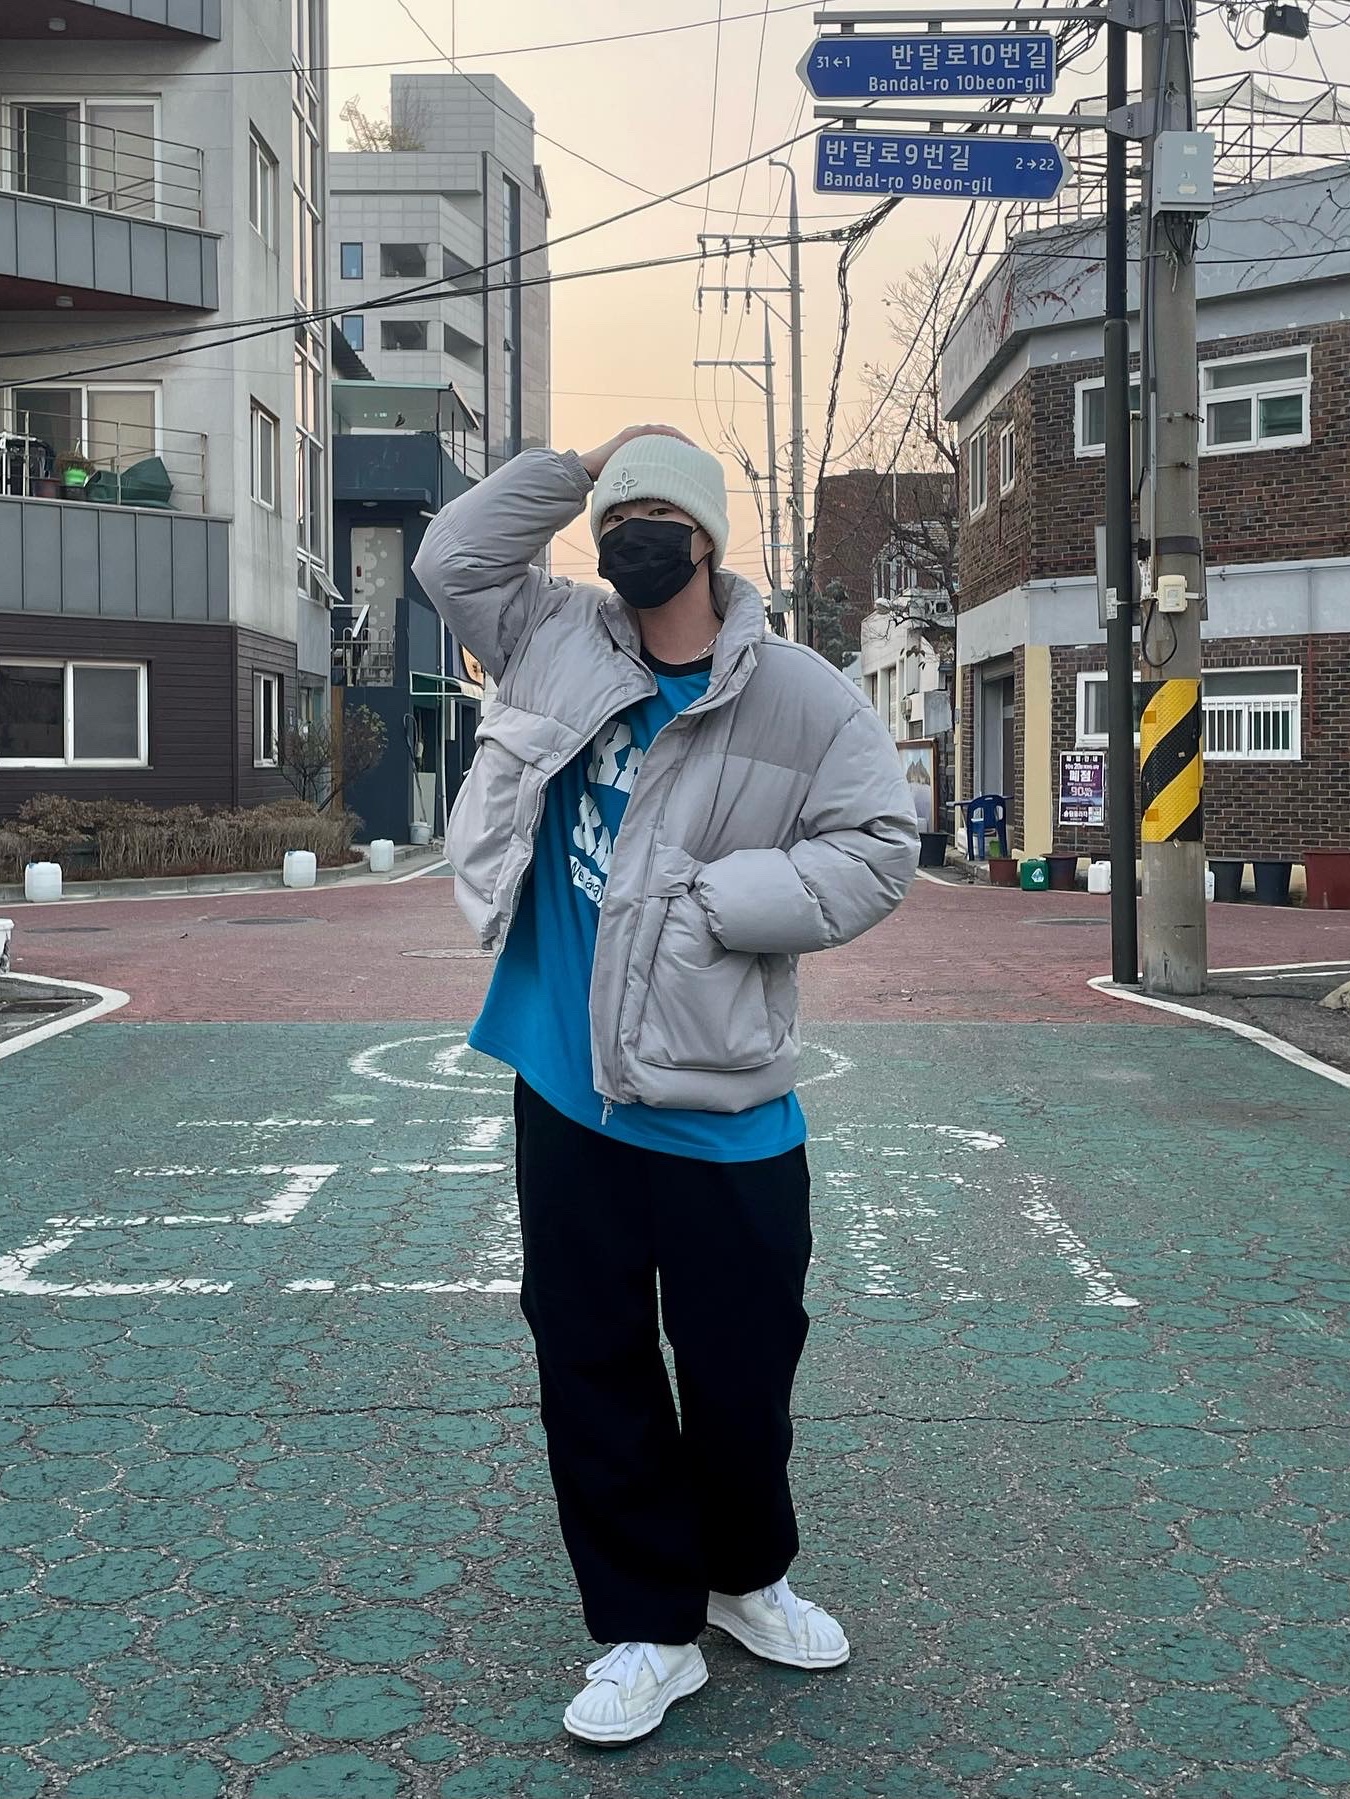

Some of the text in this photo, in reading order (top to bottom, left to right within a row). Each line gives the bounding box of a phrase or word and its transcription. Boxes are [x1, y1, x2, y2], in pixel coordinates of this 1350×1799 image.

[891, 42, 1047, 71] 반달로10번길
[868, 74, 1046, 93] Bandal-ro 10beon-gil
[825, 140, 970, 172] 반달로9번길
[823, 171, 992, 194] Bandal-ro 9beon-gil
